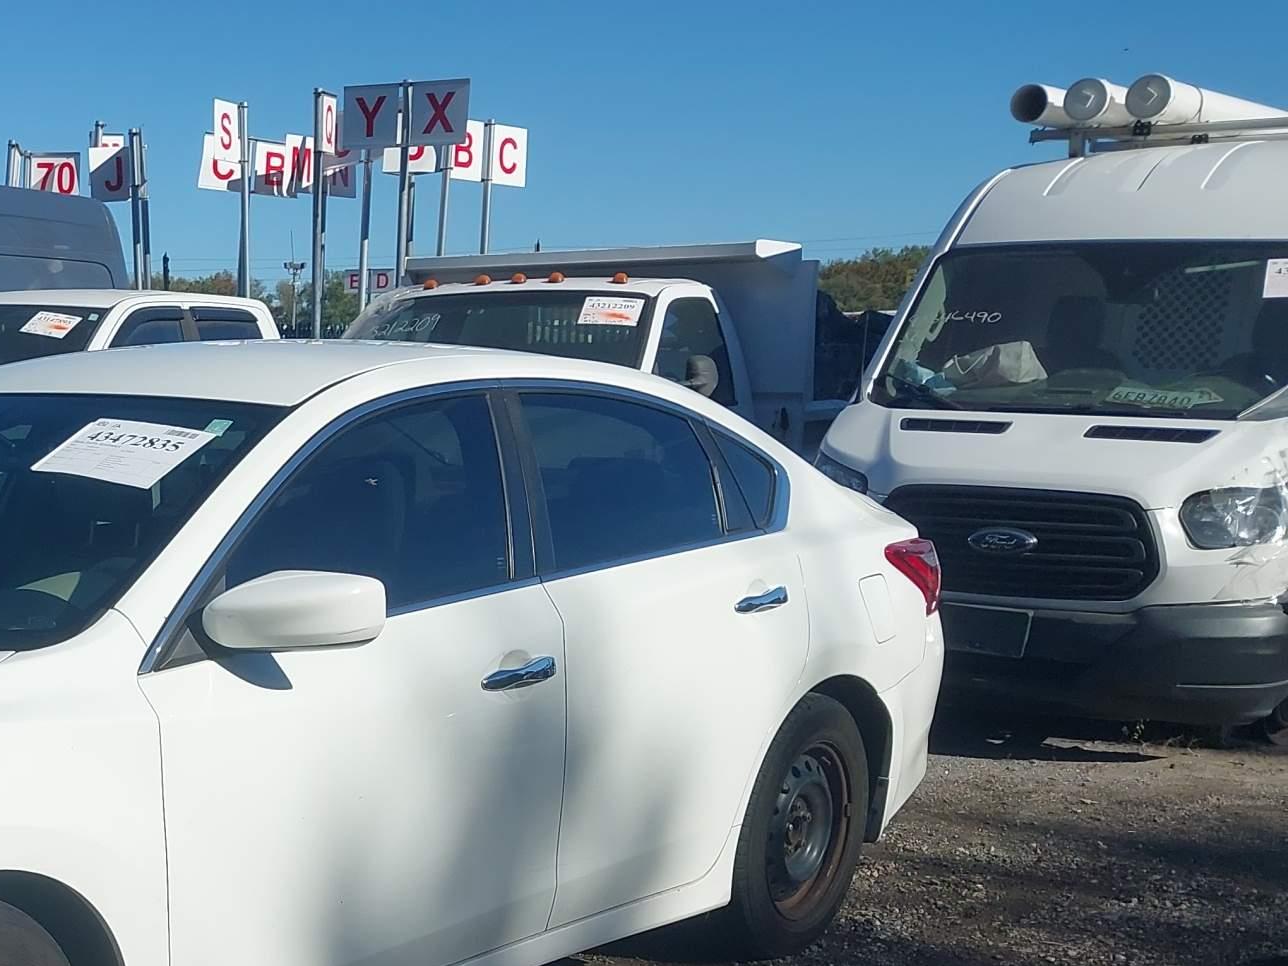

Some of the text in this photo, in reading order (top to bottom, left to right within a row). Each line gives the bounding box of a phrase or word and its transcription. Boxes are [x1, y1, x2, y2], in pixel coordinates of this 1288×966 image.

[220, 112, 232, 150] S
[325, 104, 334, 147] Q
[355, 95, 387, 138] Y
[421, 91, 456, 135] X
[454, 132, 473, 168] B
[499, 137, 518, 175] C
[36, 161, 76, 195] 70
[104, 156, 124, 192] J
[376, 273, 389, 289] D
[87, 431, 185, 452] 43472835
